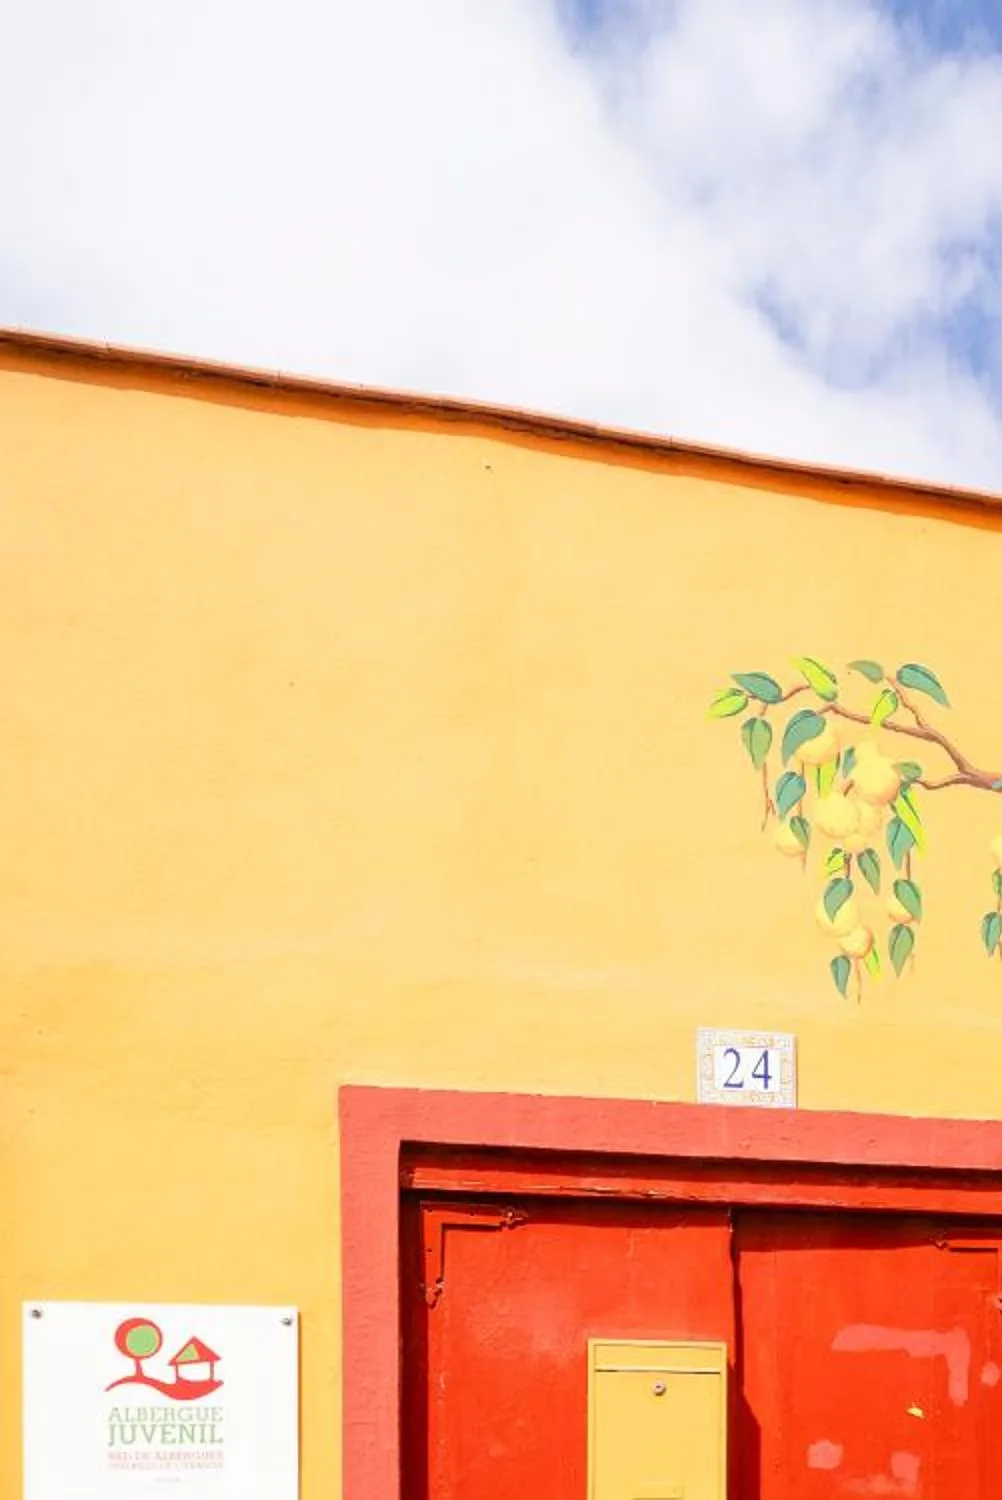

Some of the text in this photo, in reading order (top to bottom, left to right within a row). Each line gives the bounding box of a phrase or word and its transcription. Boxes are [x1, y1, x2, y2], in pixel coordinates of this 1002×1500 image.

[723, 1047, 773, 1090] 24
[108, 1406, 223, 1423] ALBERGUE
[107, 1424, 223, 1447] JUVENIL
